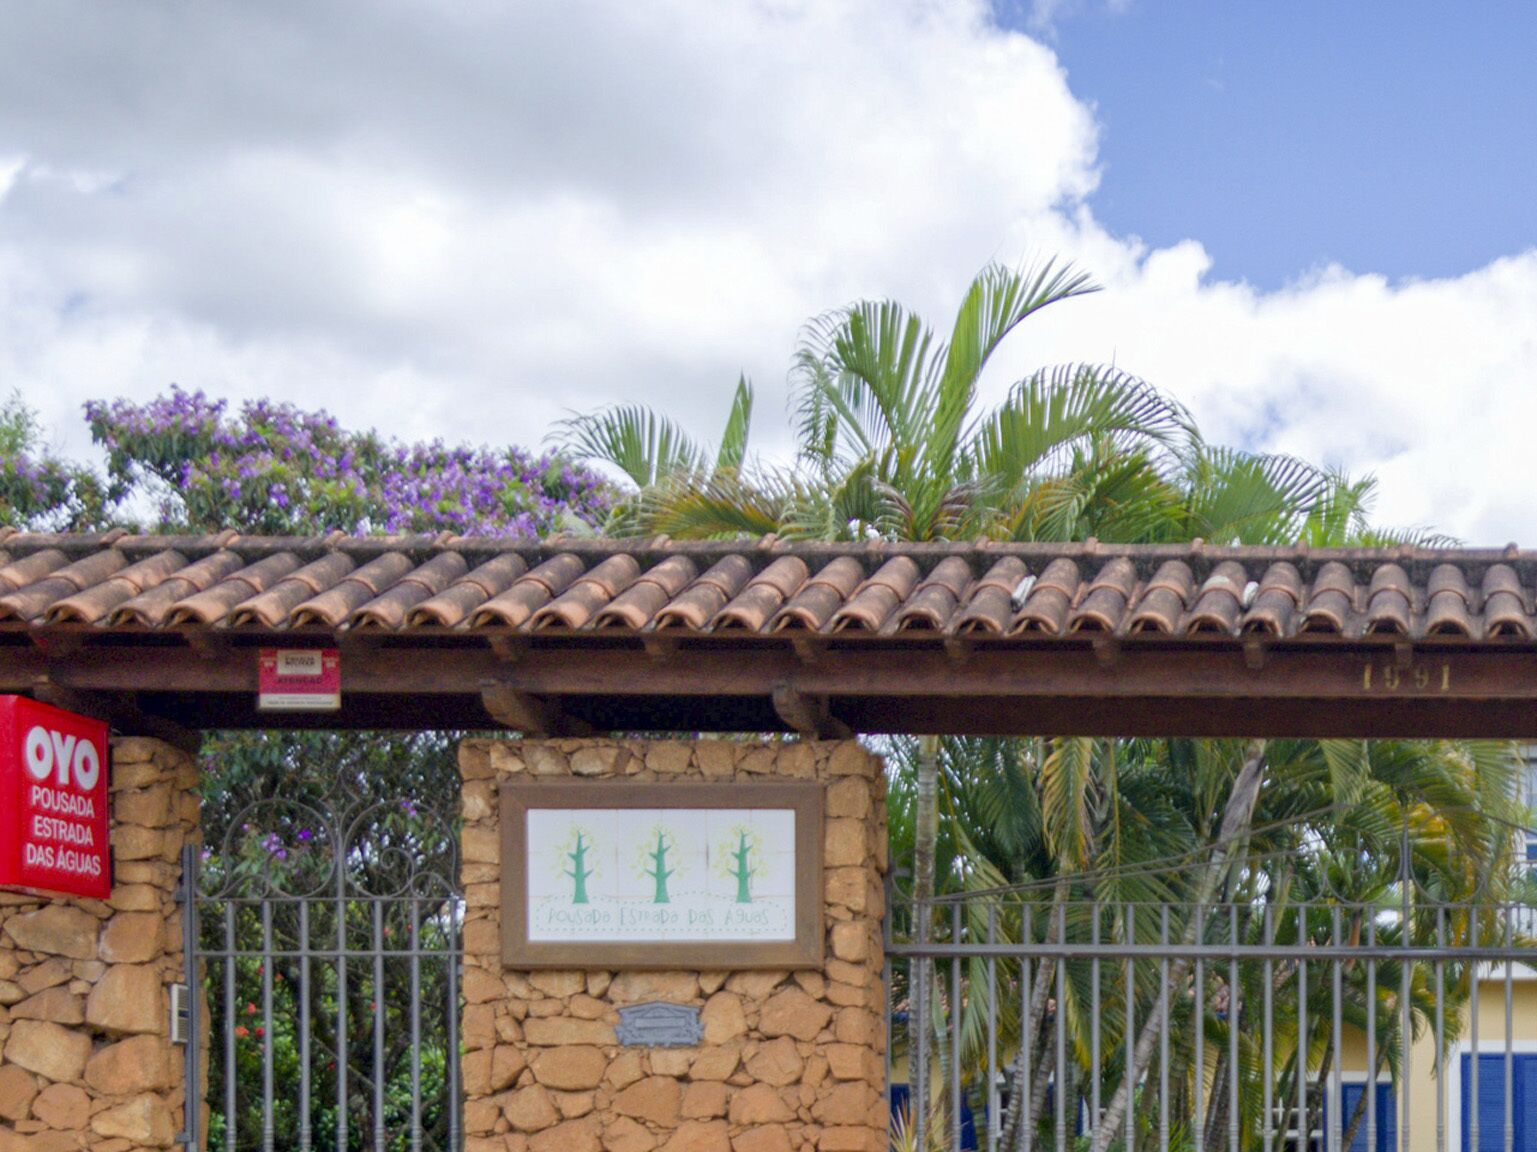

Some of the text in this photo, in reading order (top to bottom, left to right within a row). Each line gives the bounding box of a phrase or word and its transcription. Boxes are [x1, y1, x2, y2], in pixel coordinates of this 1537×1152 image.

[26, 725, 100, 791] OYO
[31, 785, 95, 819] POUSADA
[34, 815, 94, 847] ESTRADA
[26, 842, 101, 876] DAS ÁGUAS
